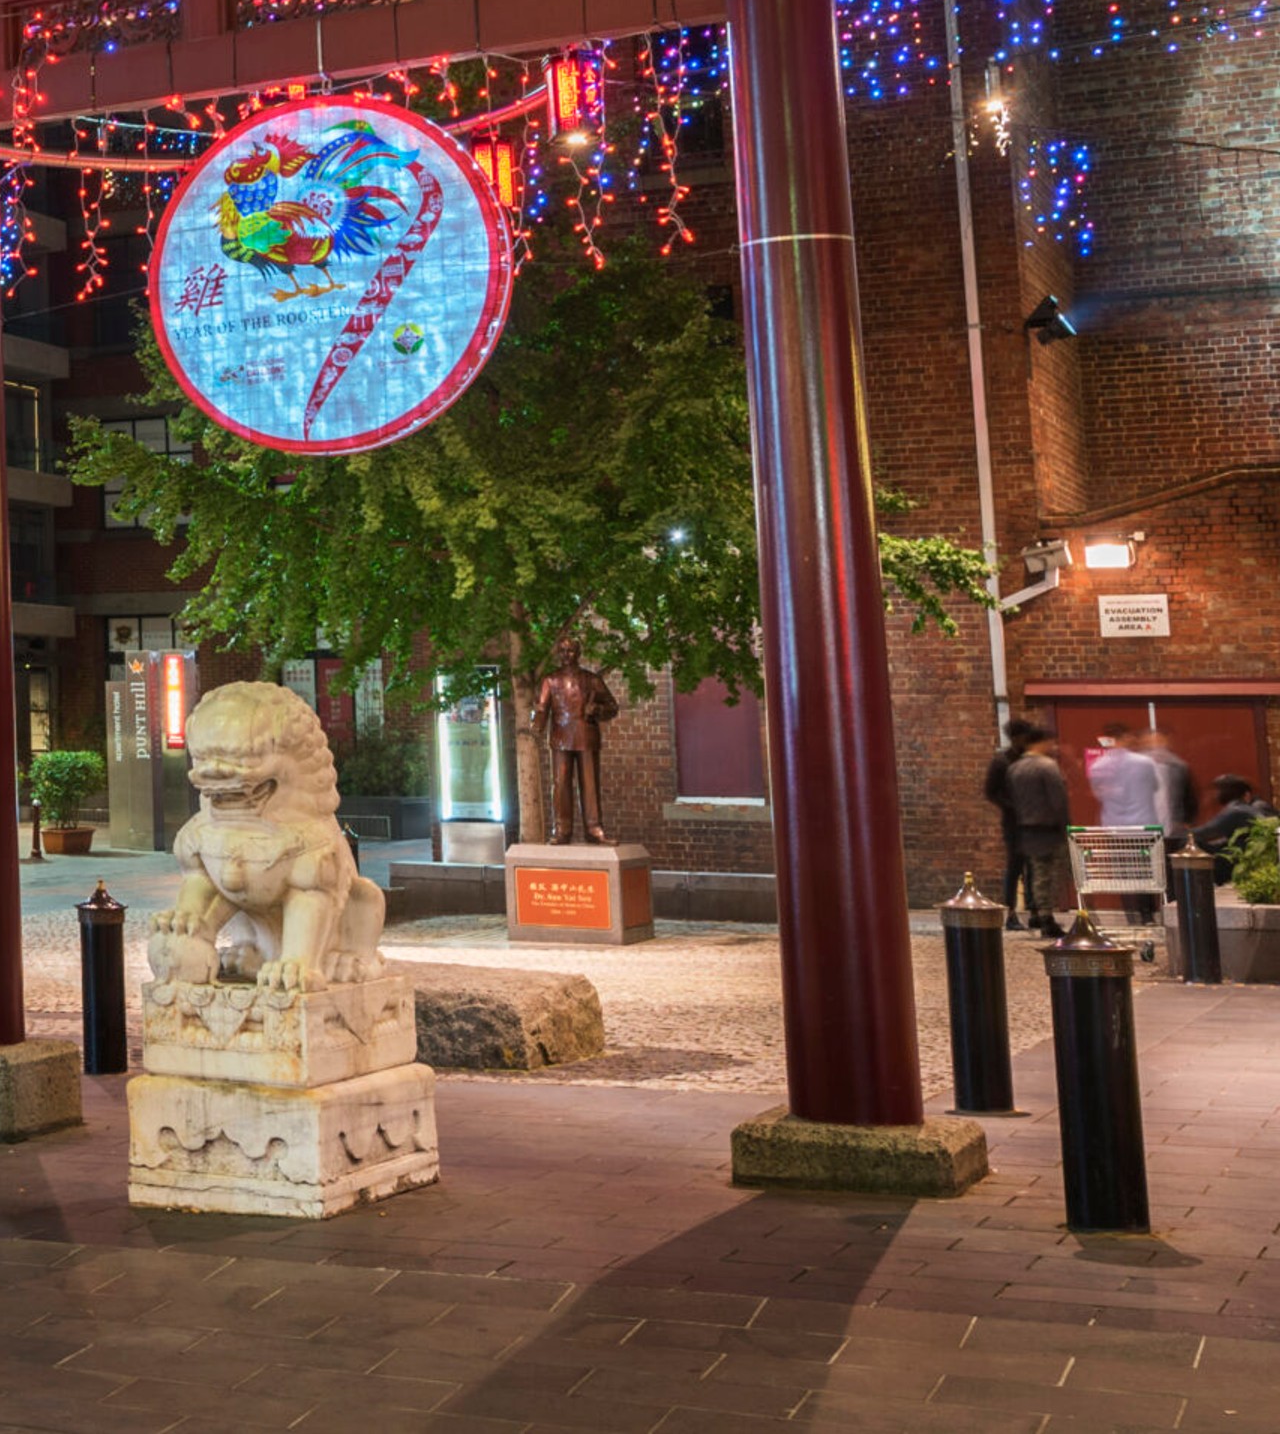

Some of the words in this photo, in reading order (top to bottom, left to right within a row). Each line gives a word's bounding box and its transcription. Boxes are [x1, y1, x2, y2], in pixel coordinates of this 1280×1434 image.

[174, 323, 213, 341] YEAR
[217, 320, 236, 335] OF
[241, 316, 270, 332] THE
[1104, 607, 1164, 615] EVACUATION
